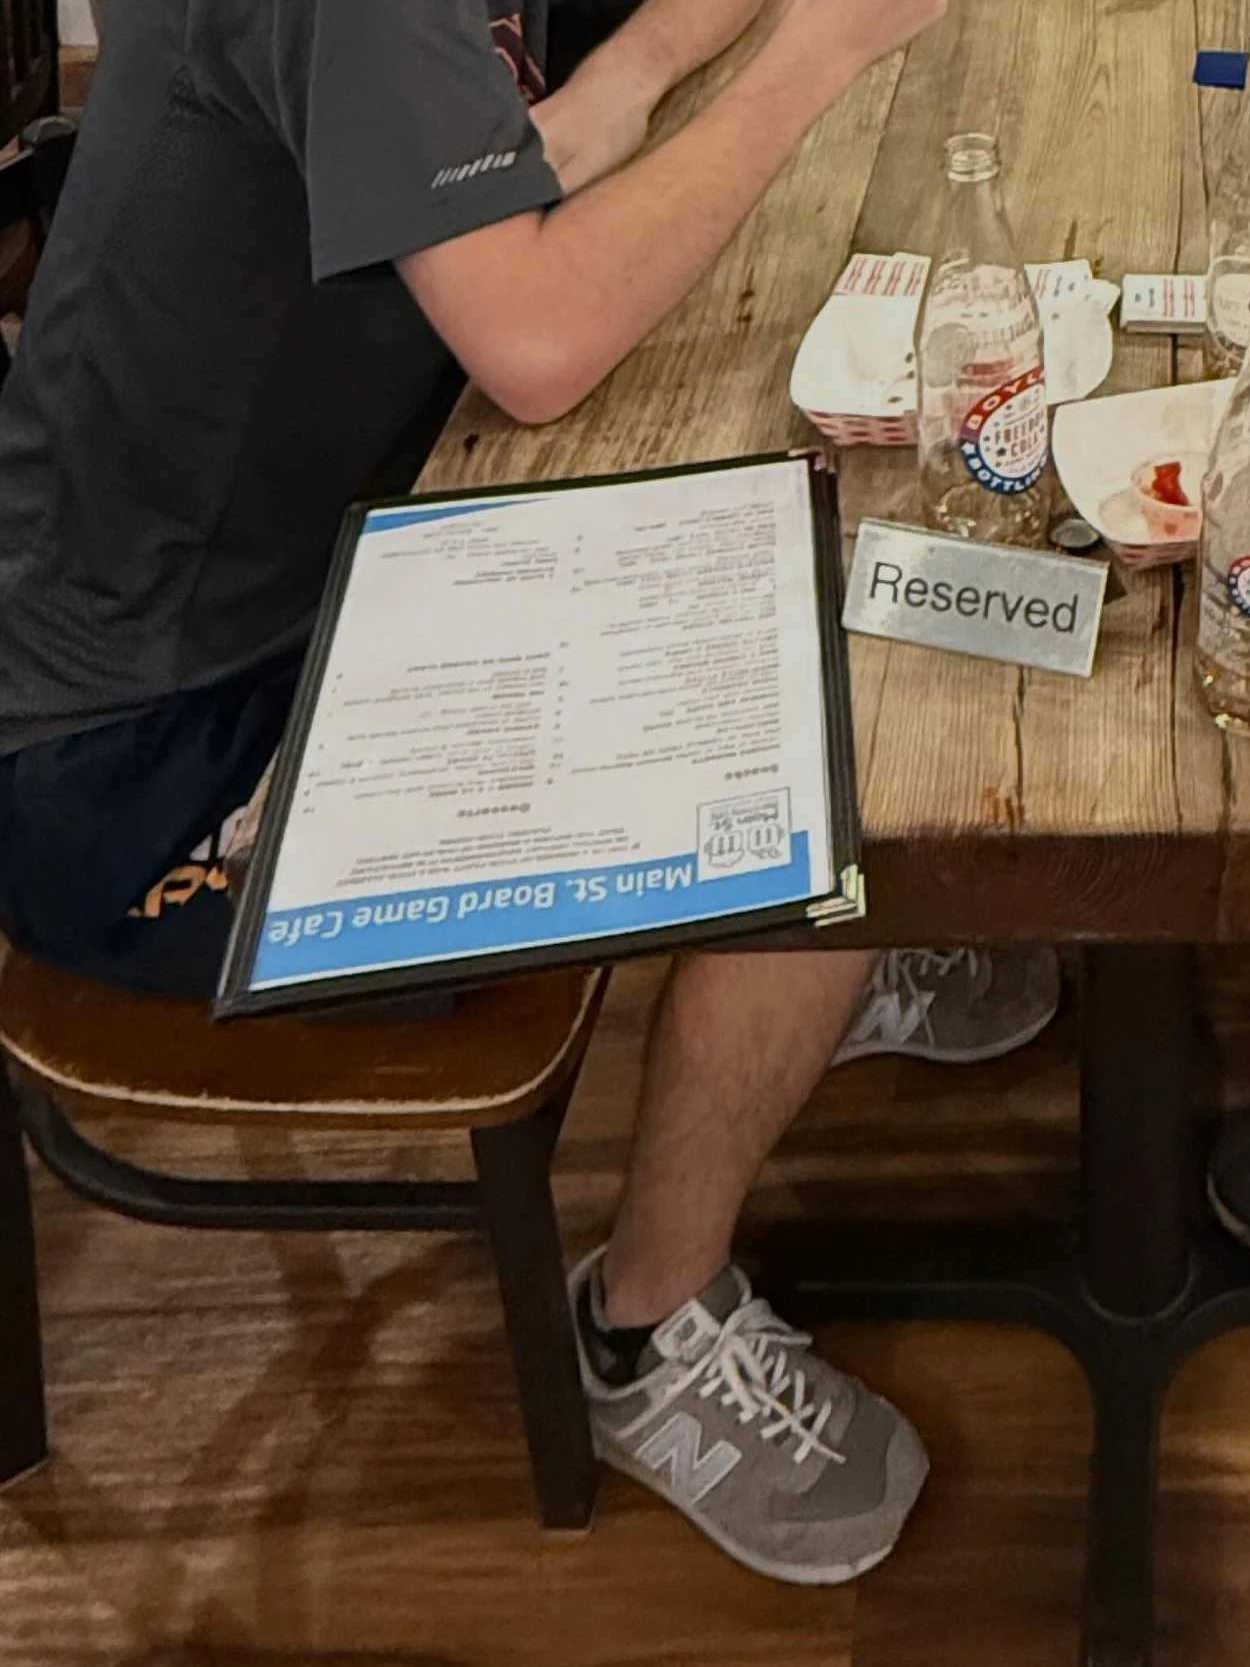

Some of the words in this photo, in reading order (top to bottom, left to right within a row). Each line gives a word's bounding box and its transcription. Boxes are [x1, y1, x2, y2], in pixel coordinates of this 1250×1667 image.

[869, 561, 1080, 634] Reserved
[564, 876, 609, 904] St.
[615, 862, 694, 896] Main
[350, 895, 450, 933] Game
[457, 882, 557, 920] Board
[266, 908, 344, 950] Cafe
[635, 1410, 744, 1507] N
